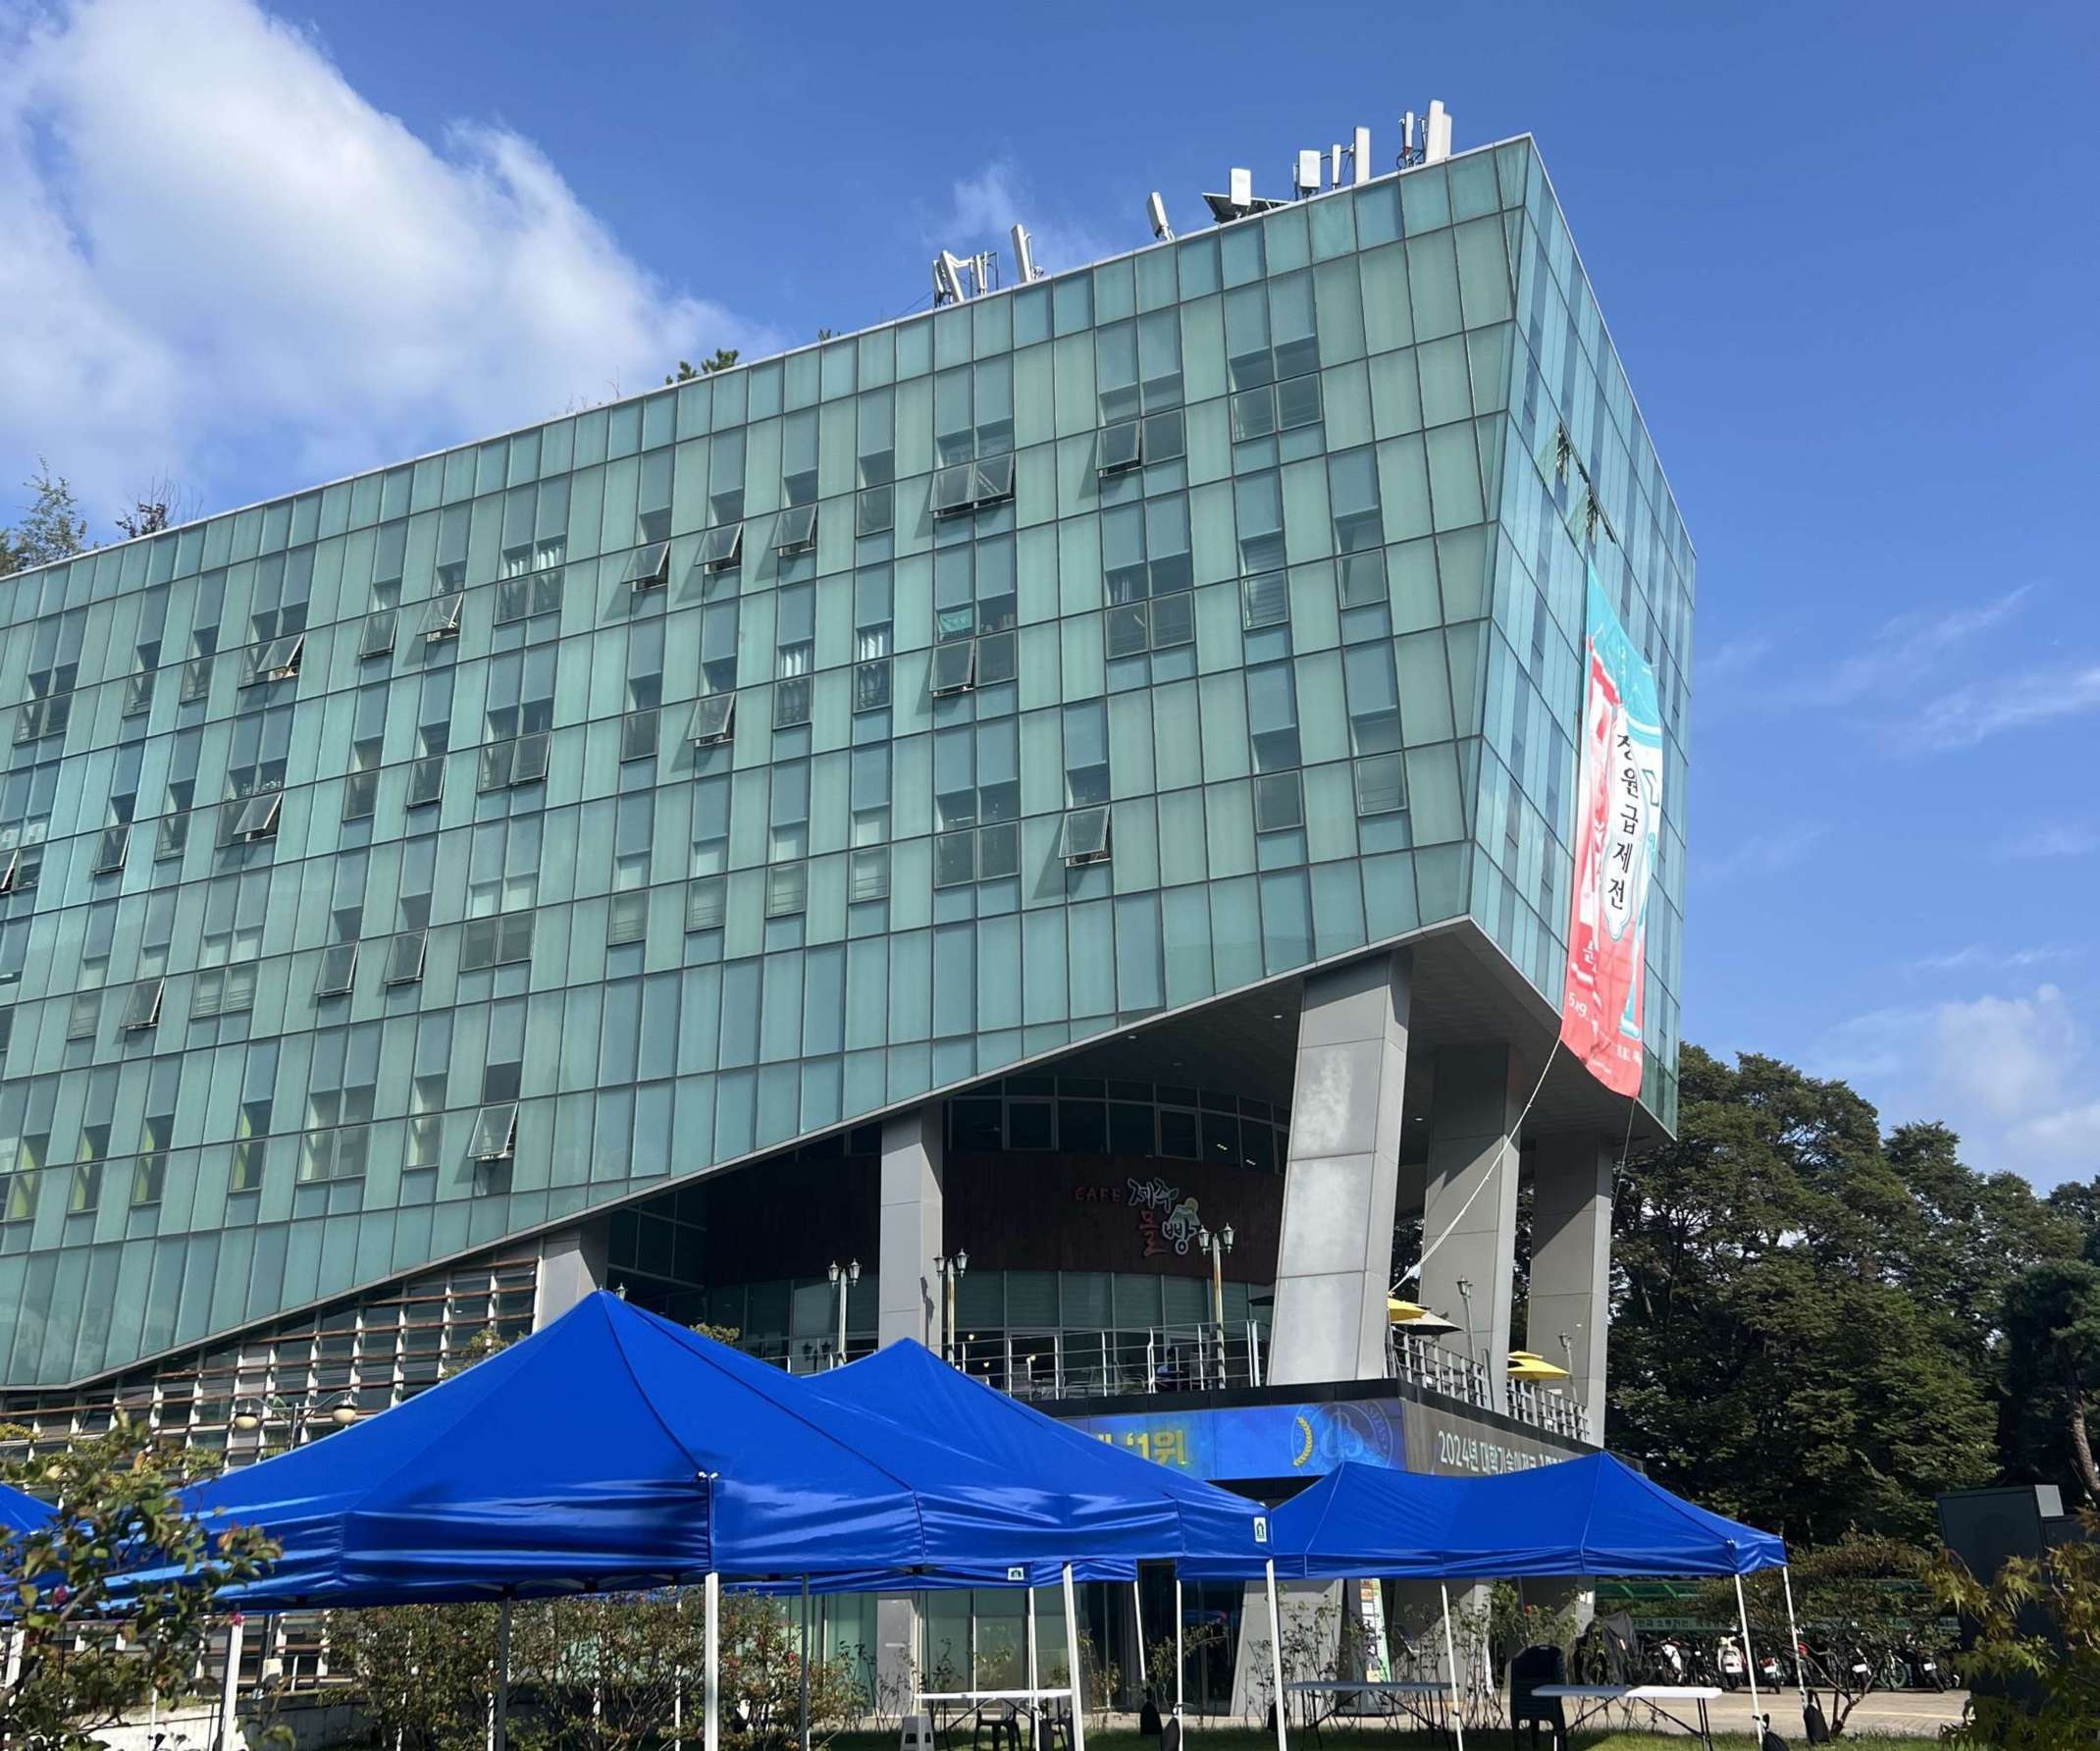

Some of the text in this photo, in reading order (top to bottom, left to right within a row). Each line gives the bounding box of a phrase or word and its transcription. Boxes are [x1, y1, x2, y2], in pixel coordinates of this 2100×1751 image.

[1075, 1186, 1122, 1202] CAFE
[1128, 1177, 1179, 1214] 제주
[1438, 1429, 1479, 1472] 2024년
